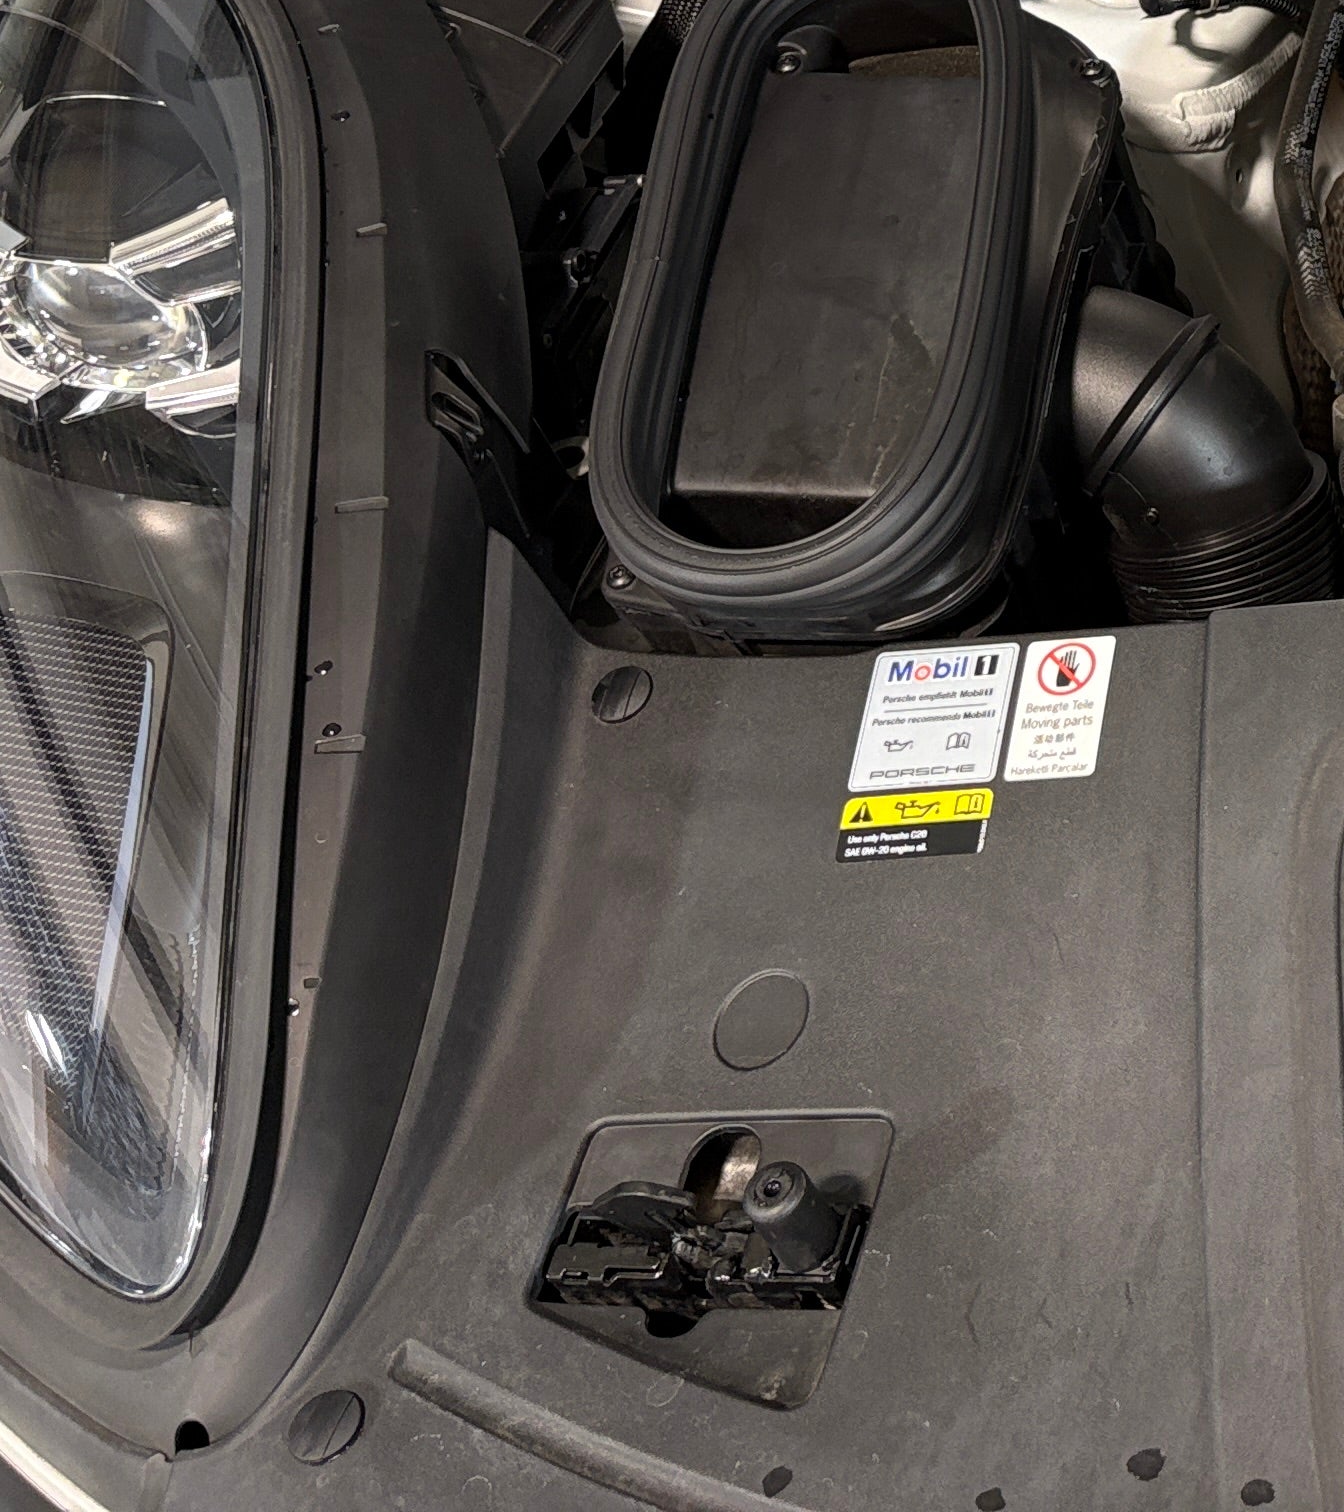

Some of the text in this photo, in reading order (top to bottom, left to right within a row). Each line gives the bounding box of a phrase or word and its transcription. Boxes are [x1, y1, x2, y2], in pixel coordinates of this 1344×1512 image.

[888, 655, 968, 682] Mobil
[882, 693, 917, 703] Porsche
[1025, 699, 1094, 713] Bewegte Teile
[872, 716, 906, 726] Porsche
[907, 713, 961, 724] recommends
[1021, 715, 1094, 729] Moving parts
[869, 764, 976, 780] PORSCHE
[1011, 762, 1088, 775] Hareketli Parçalar
[847, 835, 862, 844] Use
[863, 834, 879, 843] only
[880, 831, 910, 841] Porsche
[844, 848, 860, 857] SAE
[861, 846, 889, 856] 0W-20
[890, 844, 915, 854] engine
